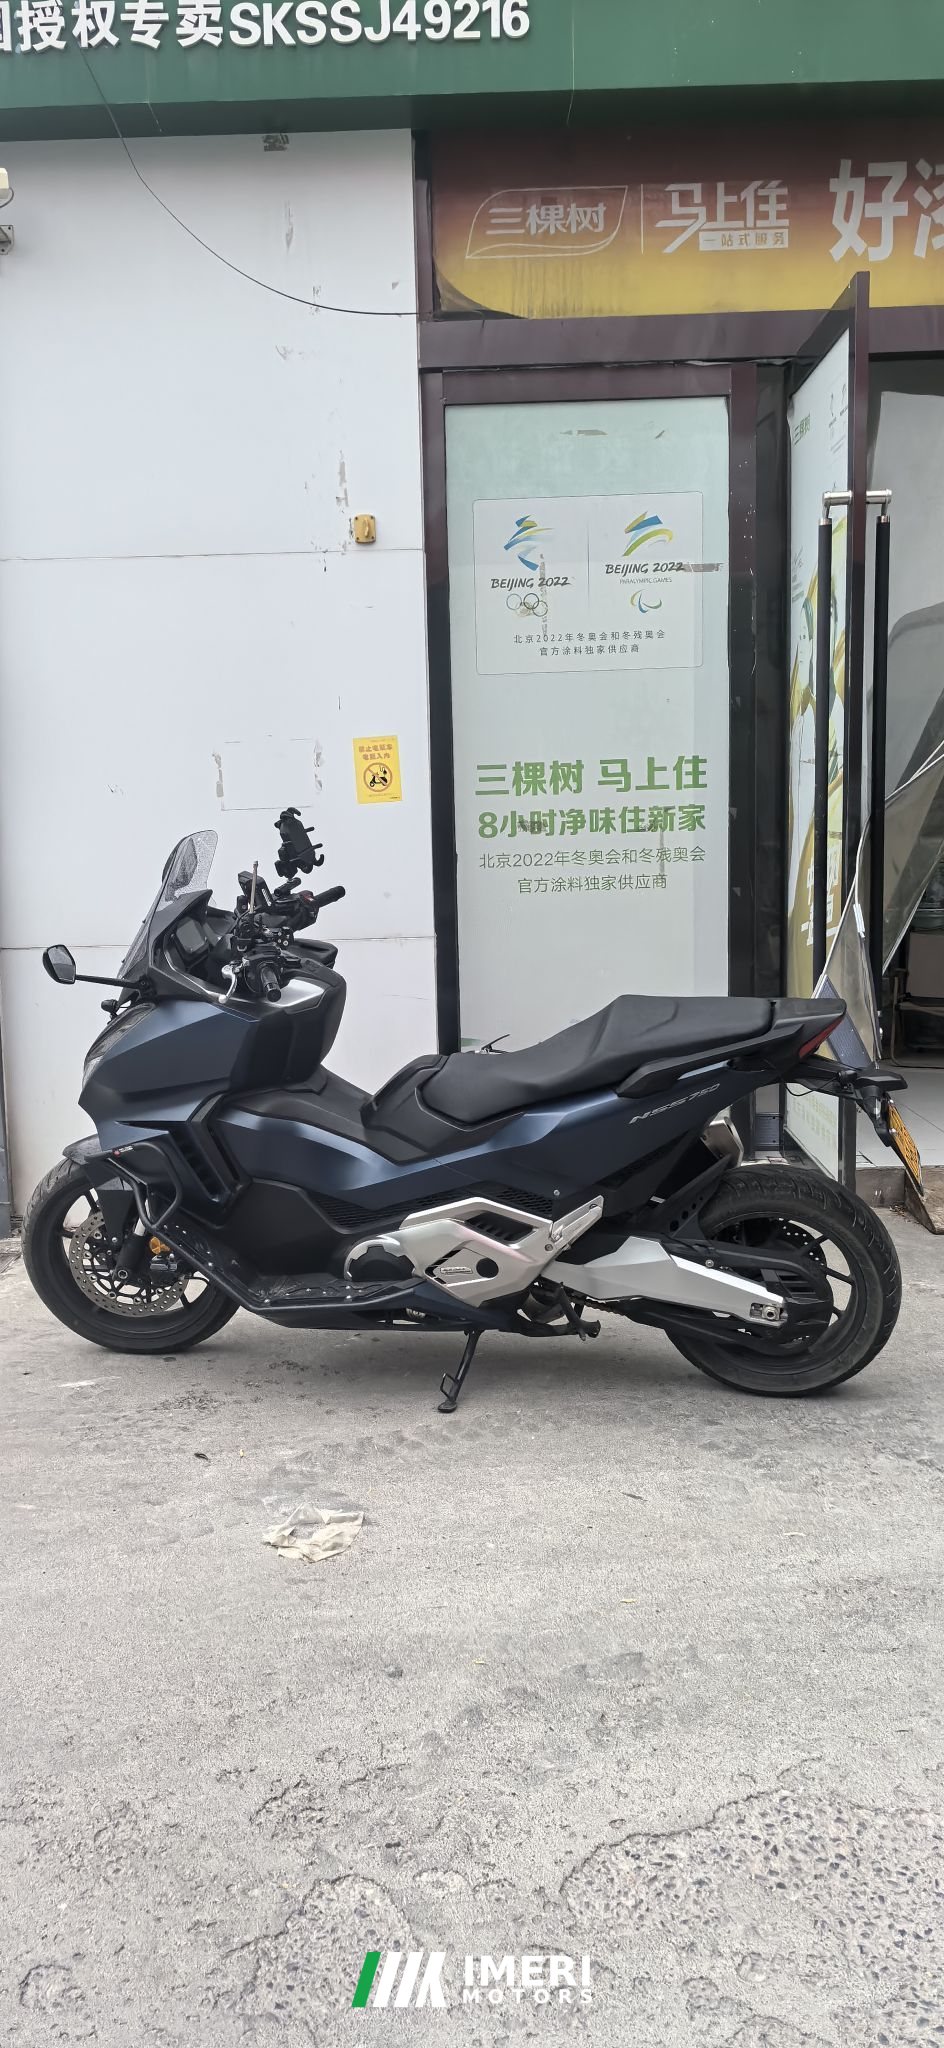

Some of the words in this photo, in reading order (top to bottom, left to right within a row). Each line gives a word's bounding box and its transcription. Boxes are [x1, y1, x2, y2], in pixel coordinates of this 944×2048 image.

[486, 202, 606, 235] 三棵树
[655, 180, 790, 254] 马上住
[703, 232, 785, 248] 一站式服务
[605, 563, 648, 577] BEIJING
[652, 561, 684, 573] 2022
[491, 578, 534, 590] BEIJING
[538, 576, 571, 588] 2022
[514, 629, 666, 645] 北京2022年冬奥会和冬残奥会
[540, 644, 640, 657] 官方涂料独家供应商
[475, 758, 585, 796] 三棵树
[597, 754, 708, 793] 马上住
[478, 803, 707, 839] 8小时净味住新家
[479, 845, 707, 869] 北京2022年冬奥会和冬残奥会
[517, 873, 668, 894] 官方涂料独家供应商
